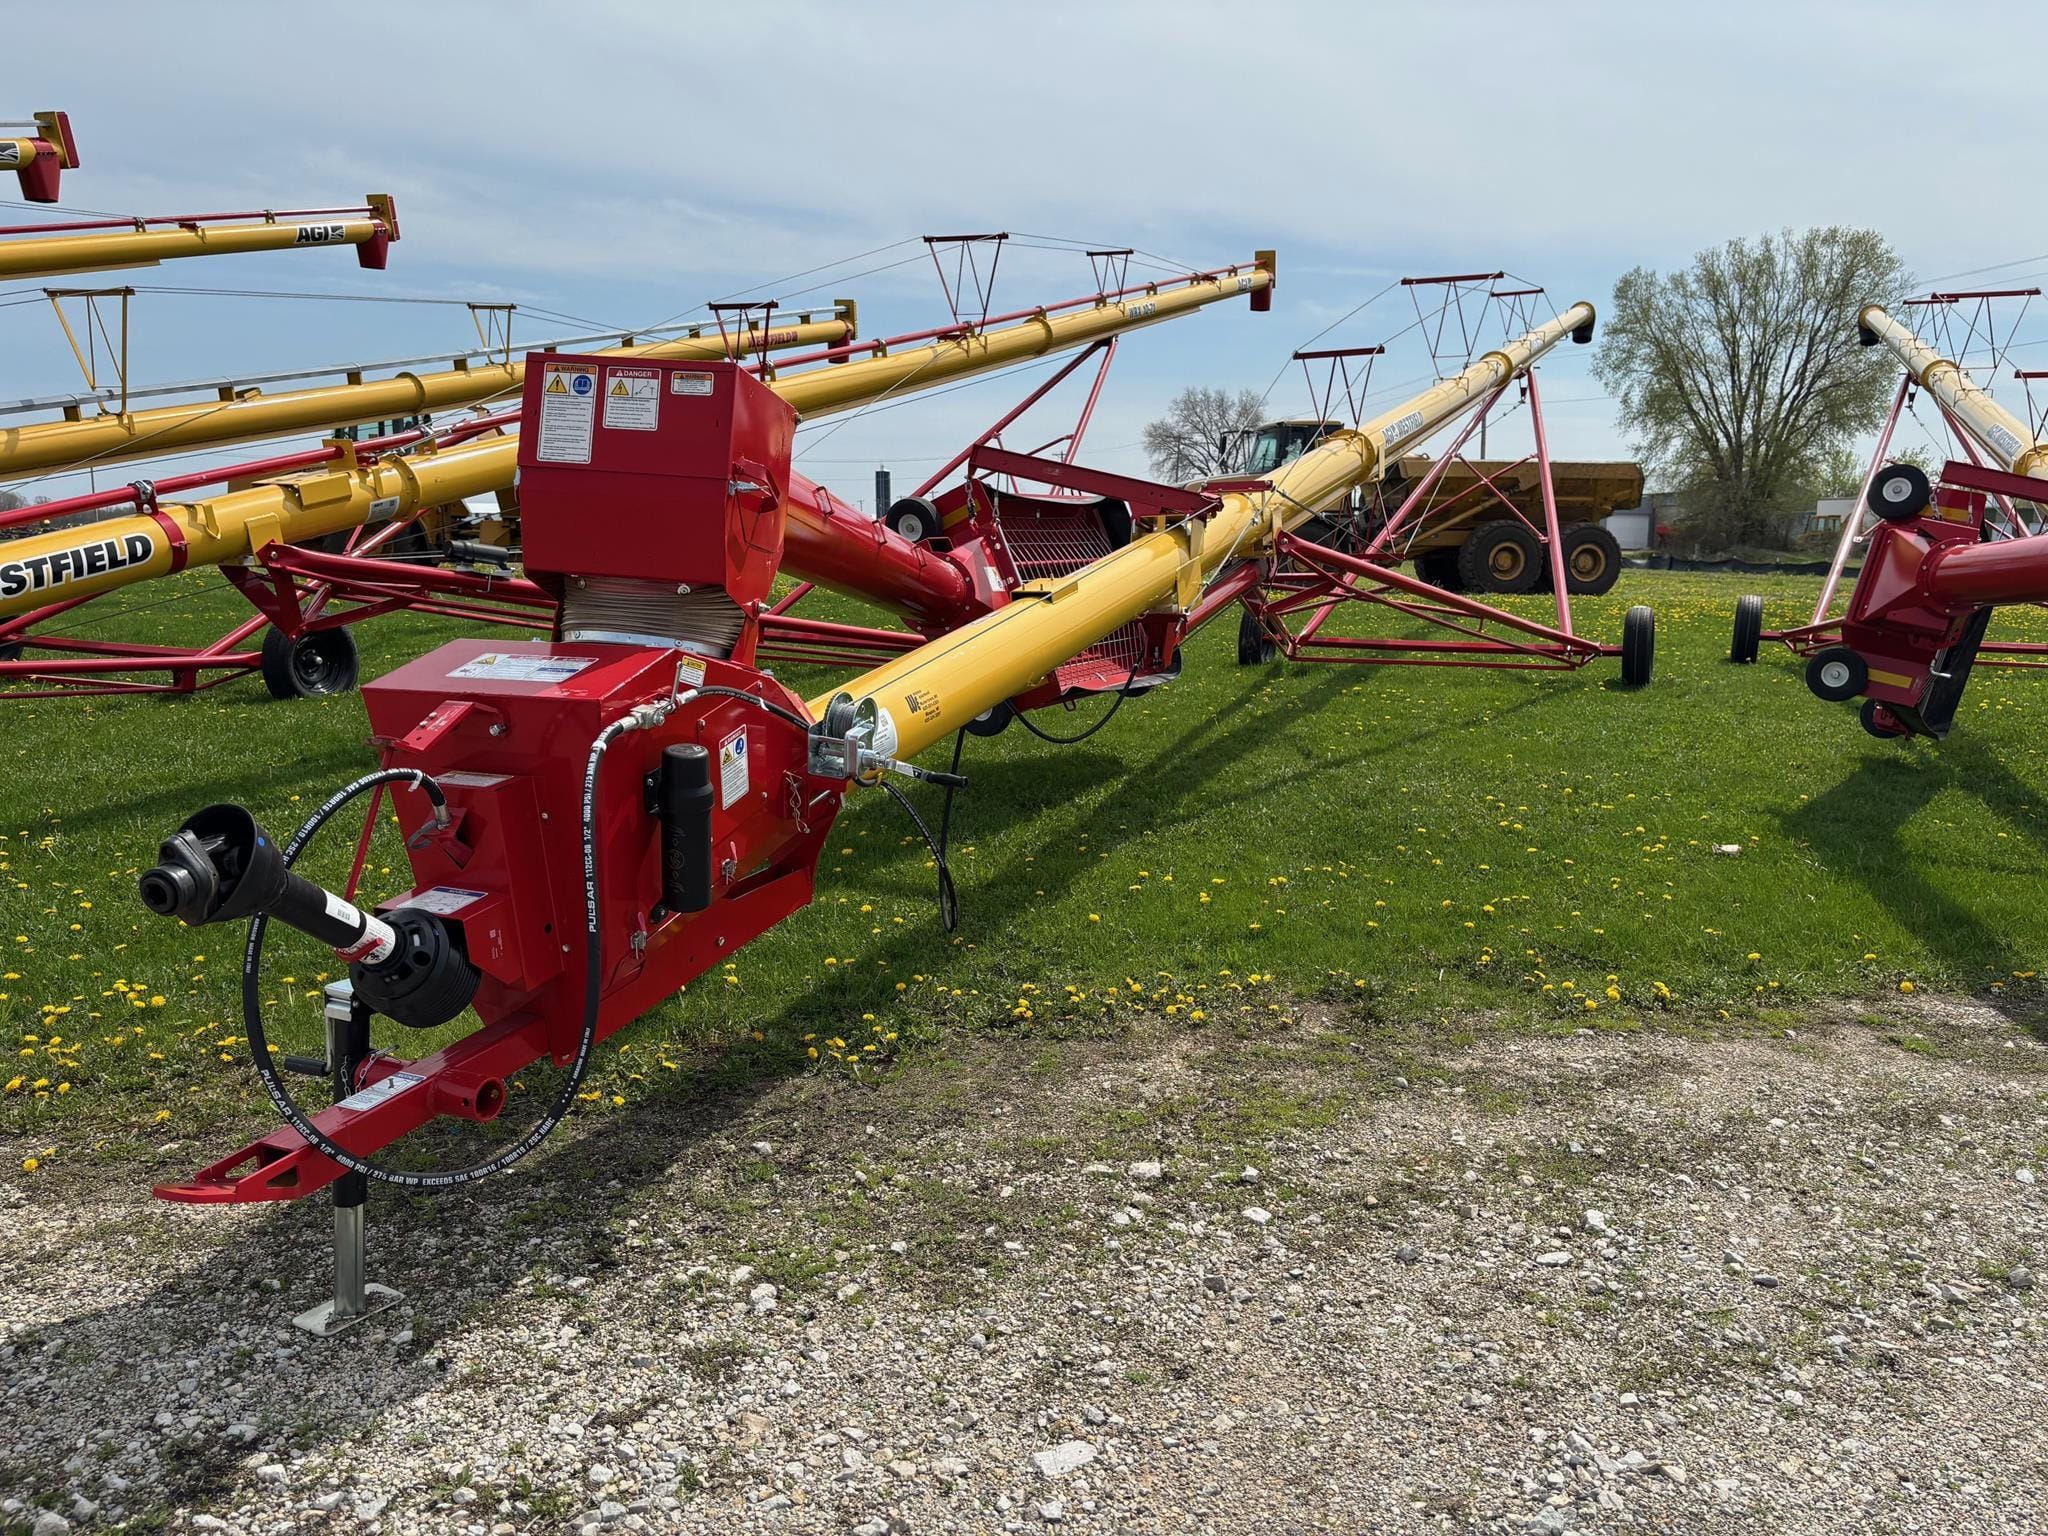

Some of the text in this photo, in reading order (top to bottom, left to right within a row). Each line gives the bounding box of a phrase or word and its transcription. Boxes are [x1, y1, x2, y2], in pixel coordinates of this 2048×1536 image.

[296, 226, 329, 242] AGI
[0, 535, 152, 596] STFIELD
[344, 781, 360, 794] SAE
[584, 775, 593, 788] 275
[324, 790, 347, 812] 100R16
[583, 793, 592, 804] PSI
[583, 805, 591, 822] 4000
[586, 881, 597, 933] PULSAR
[260, 1069, 293, 1116] PULSAR
[335, 1154, 353, 1169] 4000
[353, 1163, 366, 1175] PSI
[372, 1170, 387, 1181] 275
[388, 1174, 404, 1184] BAR
[405, 1177, 419, 1186] WP
[422, 1176, 453, 1186] EXCEEDS
[455, 1173, 469, 1183] SAE
[469, 1163, 497, 1179] 100R16
[529, 1133, 542, 1146] 2SC
[539, 1116, 556, 1135] HARC
